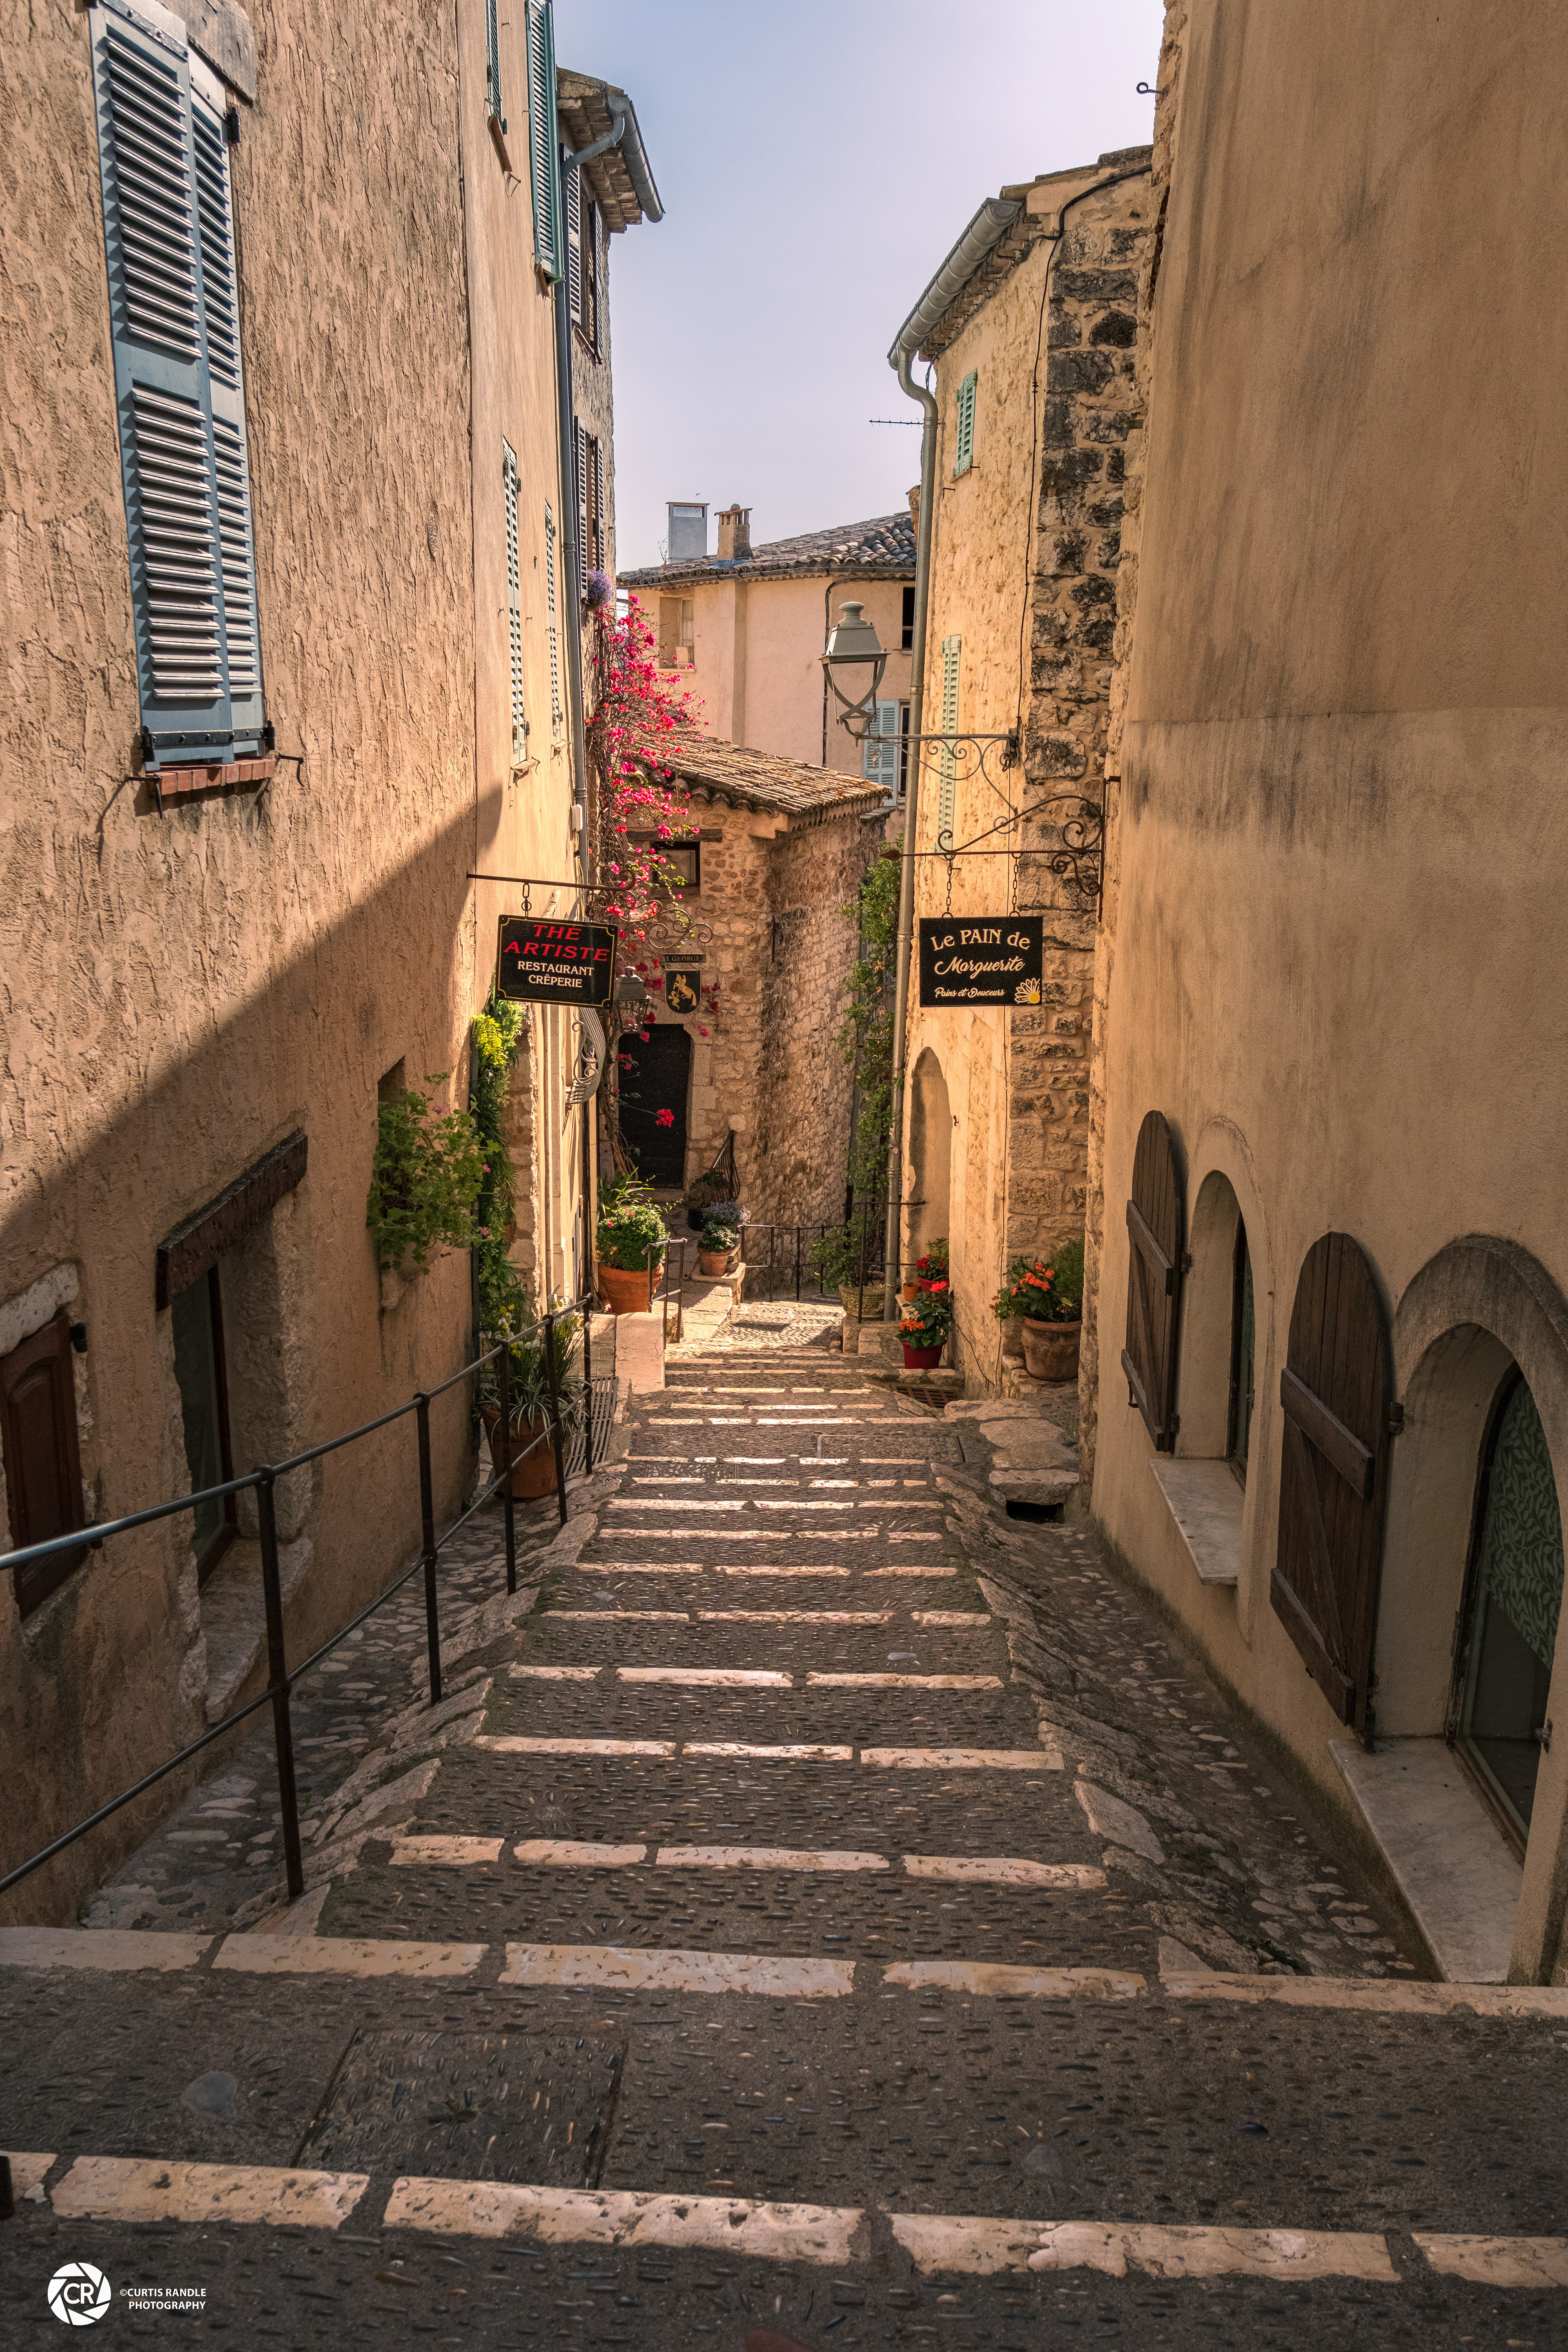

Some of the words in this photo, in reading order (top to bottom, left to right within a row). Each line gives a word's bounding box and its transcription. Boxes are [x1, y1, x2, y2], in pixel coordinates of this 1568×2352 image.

[931, 935, 955, 951] Le
[960, 929, 1002, 944] PAIN
[1007, 932, 1030, 950] de
[504, 942, 610, 961] ARTISTE
[517, 961, 594, 976] RESTAURANT
[934, 956, 1025, 979] Marguerite
[528, 974, 582, 988] CRÊPERIE
[935, 987, 957, 998] Pains
[958, 988, 969, 996] et
[967, 987, 1005, 998] Douceurs
